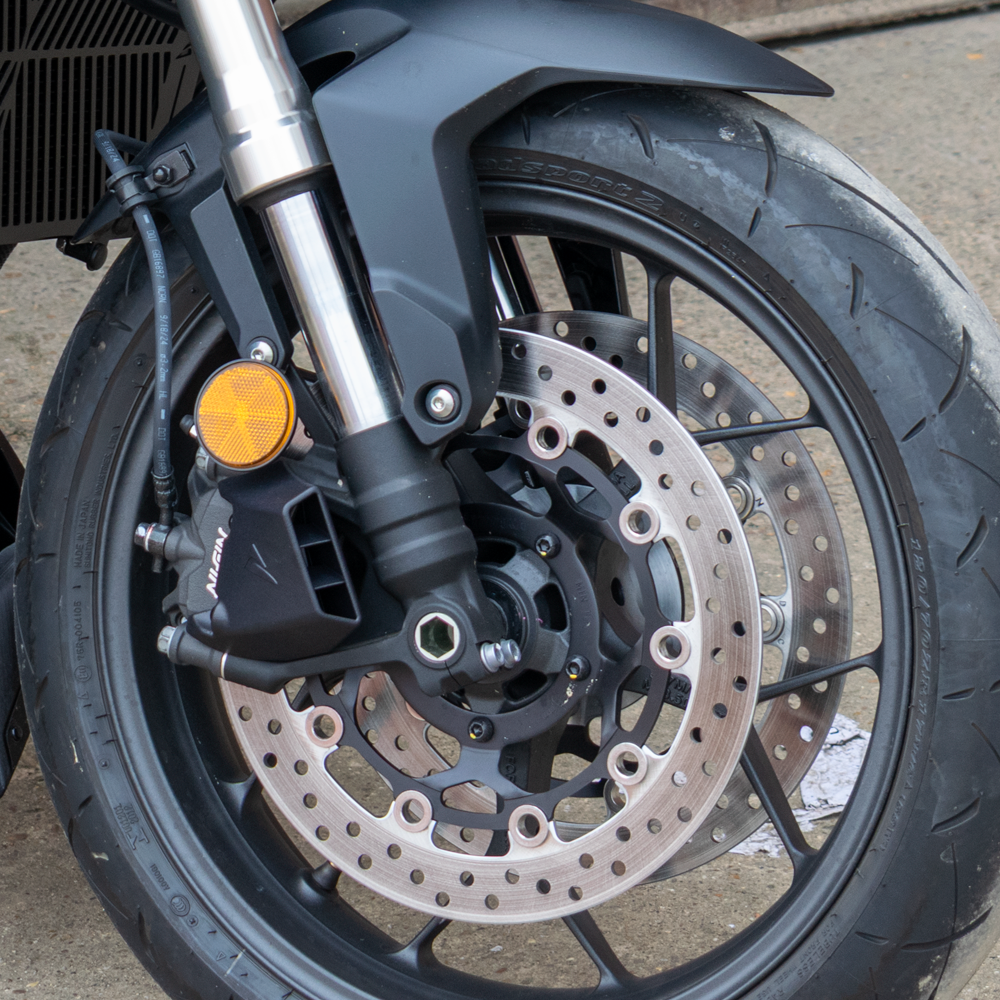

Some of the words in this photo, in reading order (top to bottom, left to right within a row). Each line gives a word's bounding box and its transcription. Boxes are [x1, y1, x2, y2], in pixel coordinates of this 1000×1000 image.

[158, 314, 169, 346] 9/18/24
[80, 500, 92, 530] JAPAN
[77, 532, 86, 542] IN
